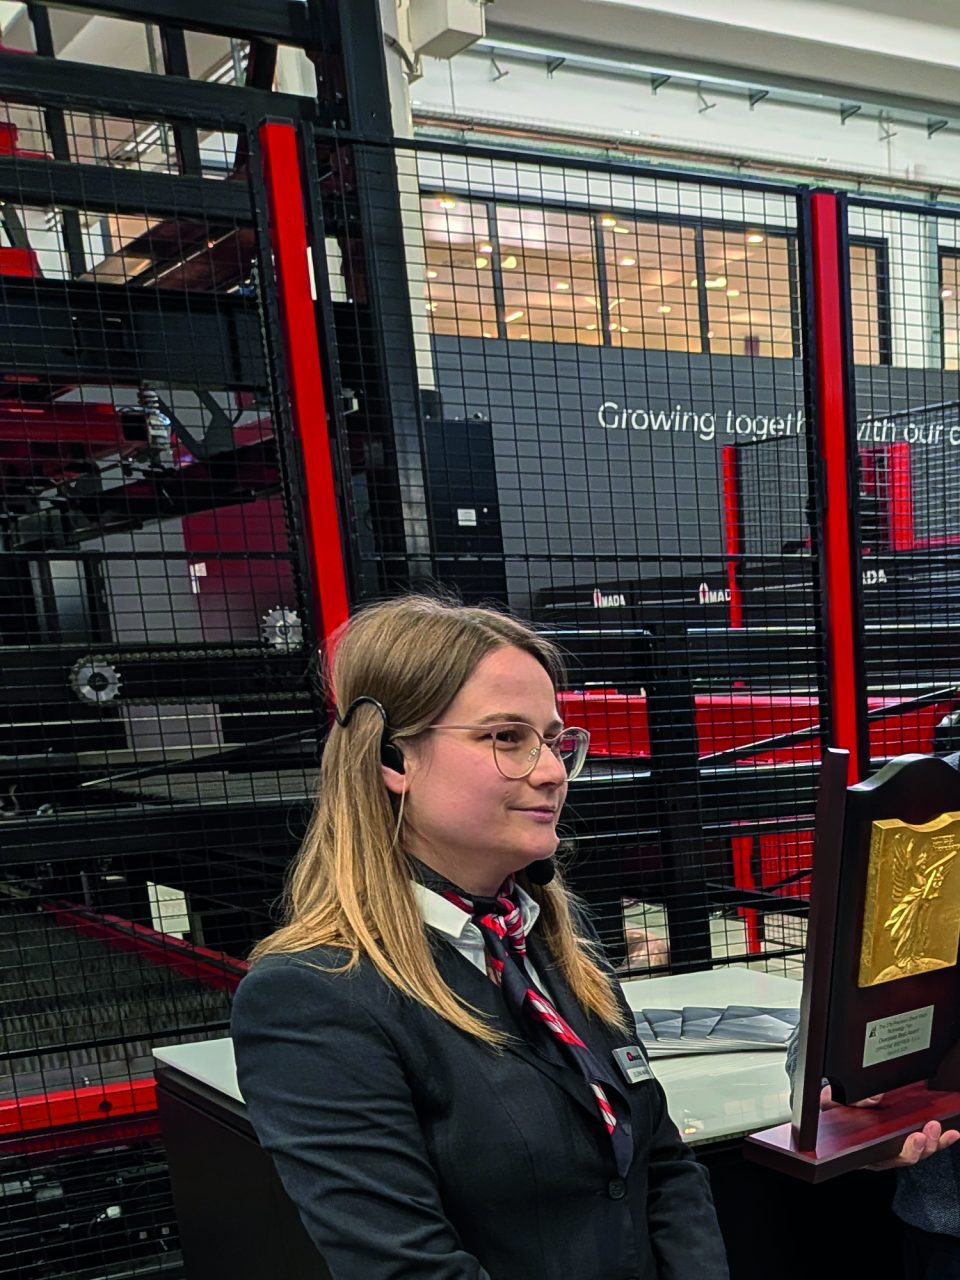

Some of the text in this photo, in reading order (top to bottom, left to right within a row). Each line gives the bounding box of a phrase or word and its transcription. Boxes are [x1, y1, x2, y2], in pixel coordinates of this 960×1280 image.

[598, 402, 716, 441] Growing
[726, 410, 806, 441] togeth
[903, 421, 943, 444] our
